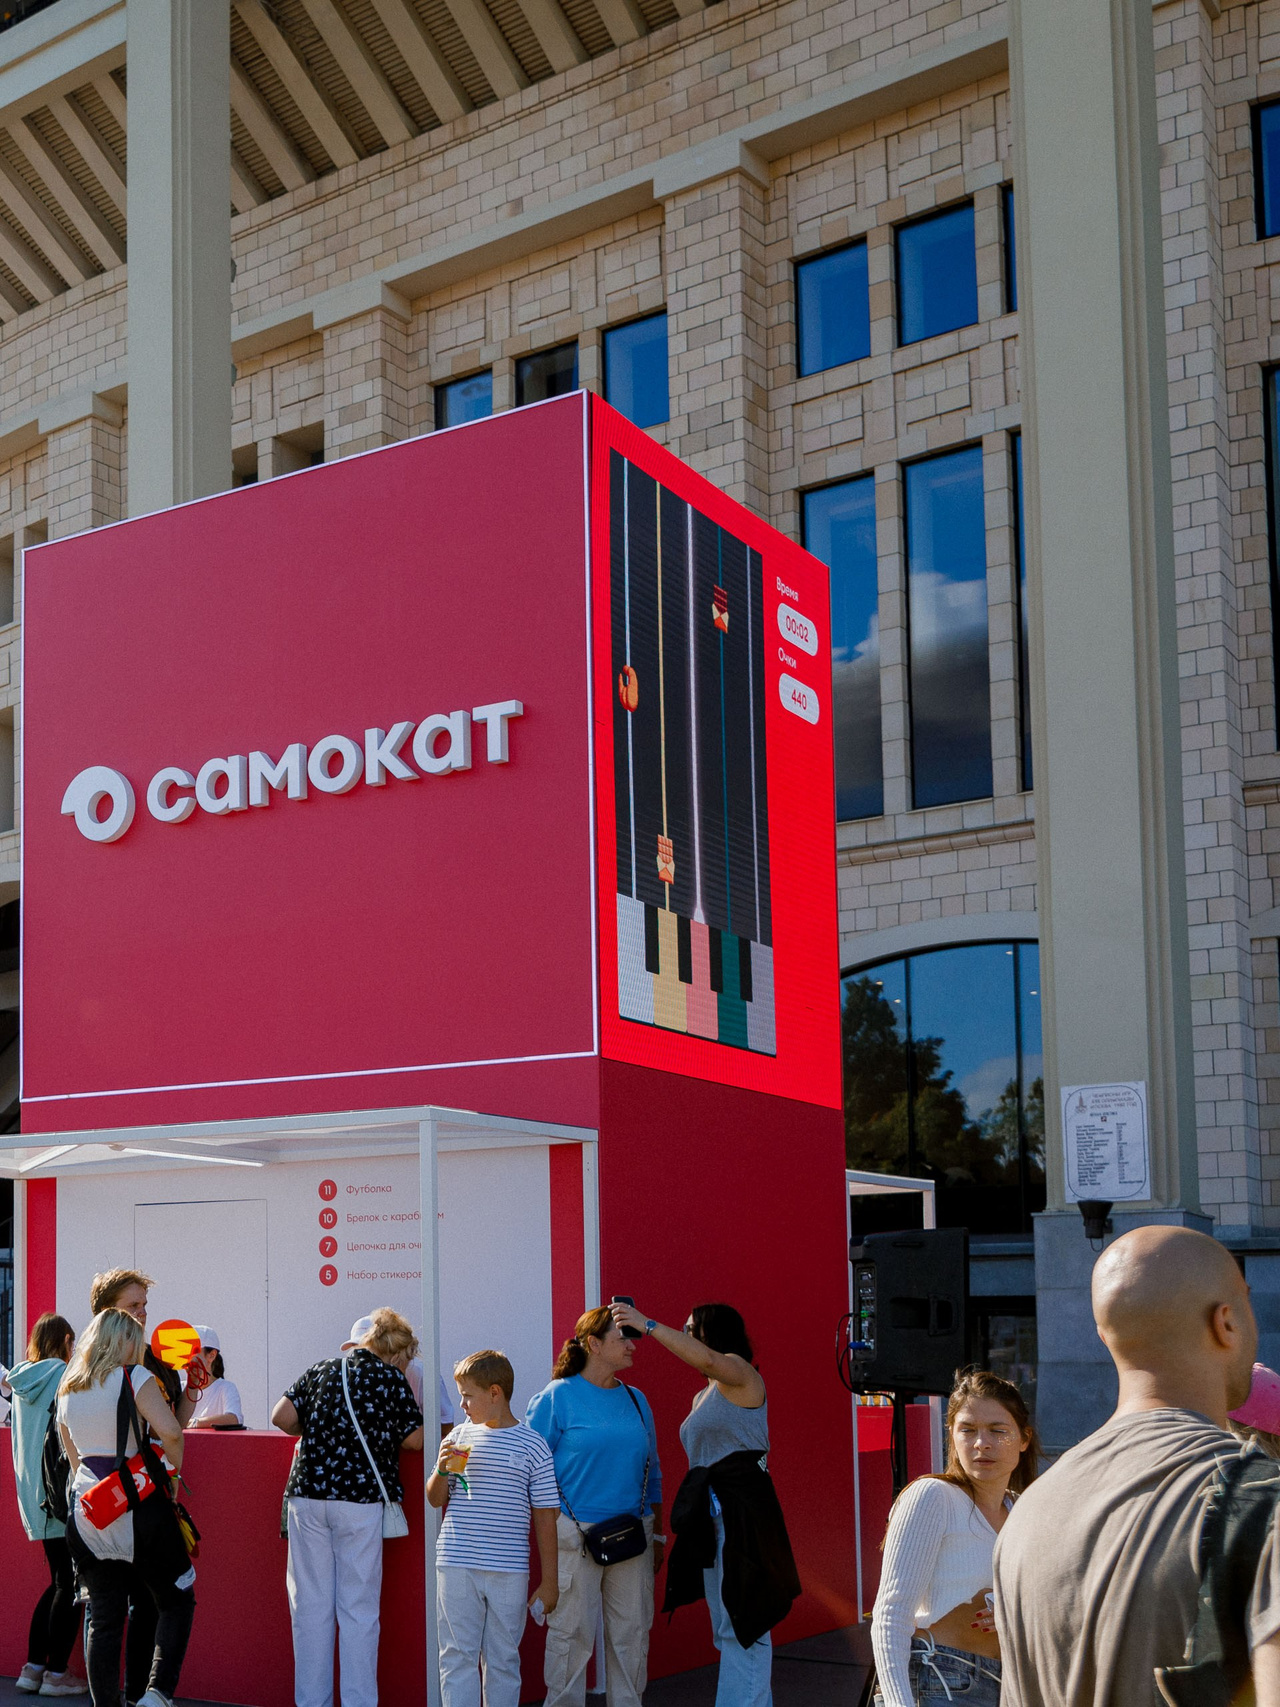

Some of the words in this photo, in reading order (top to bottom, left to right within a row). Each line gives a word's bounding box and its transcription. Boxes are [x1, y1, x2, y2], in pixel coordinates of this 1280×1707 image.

[776, 576, 799, 602] Время
[785, 615, 809, 643] 00:02
[778, 647, 797, 669] Очки
[791, 688, 808, 710] 440
[146, 699, 524, 825] самокат
[324, 1185, 332, 1196] 11
[346, 1184, 392, 1196] Футболка
[323, 1213, 333, 1223] 10
[346, 1213, 380, 1224] Брелок
[382, 1214, 388, 1222] с
[325, 1241, 332, 1252] 7
[346, 1242, 387, 1252] Цепочка
[389, 1242, 406, 1251] для
[347, 1270, 378, 1281] Набор
